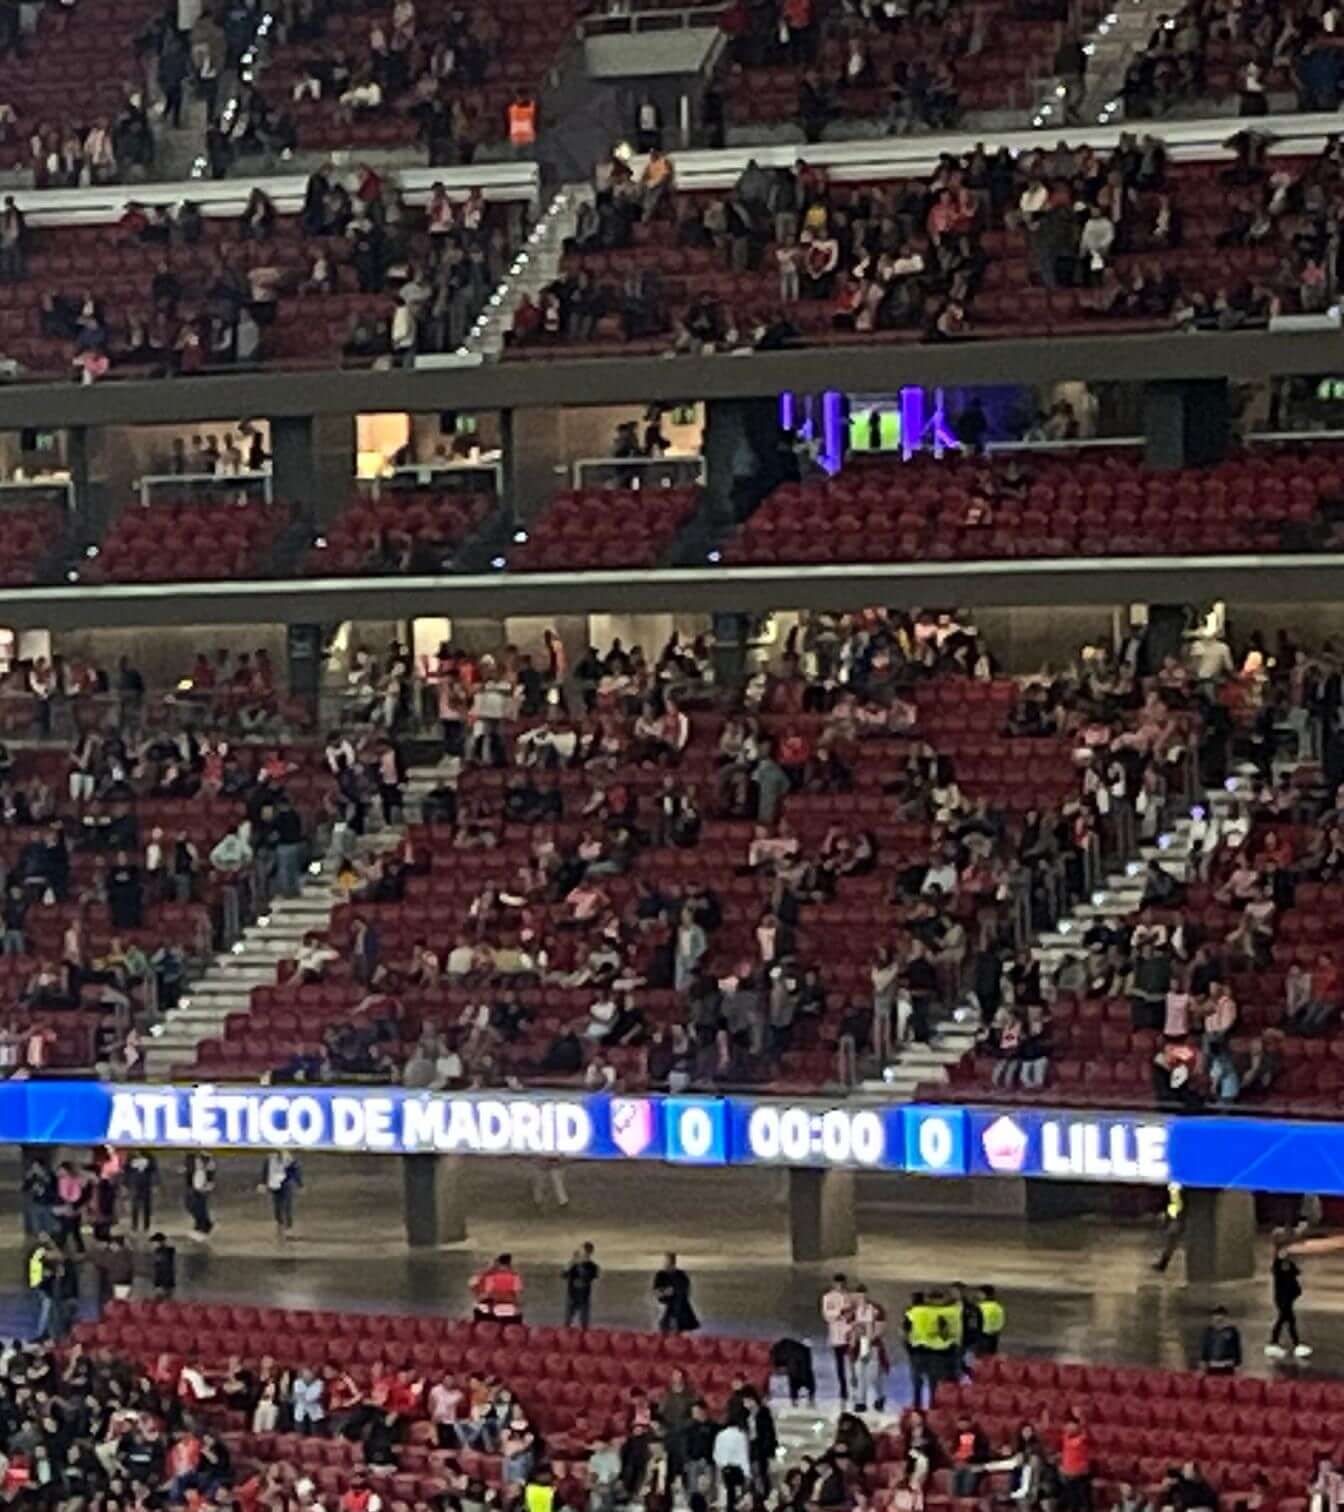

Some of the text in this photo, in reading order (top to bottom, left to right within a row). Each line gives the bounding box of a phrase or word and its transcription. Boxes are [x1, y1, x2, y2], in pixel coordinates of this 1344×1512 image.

[107, 1085, 591, 1154] ATLÉTICO DE MADRID
[680, 1107, 711, 1156] 0
[749, 1106, 884, 1163] 00:00
[920, 1118, 951, 1168] 0
[1042, 1120, 1169, 1181] LILLE
